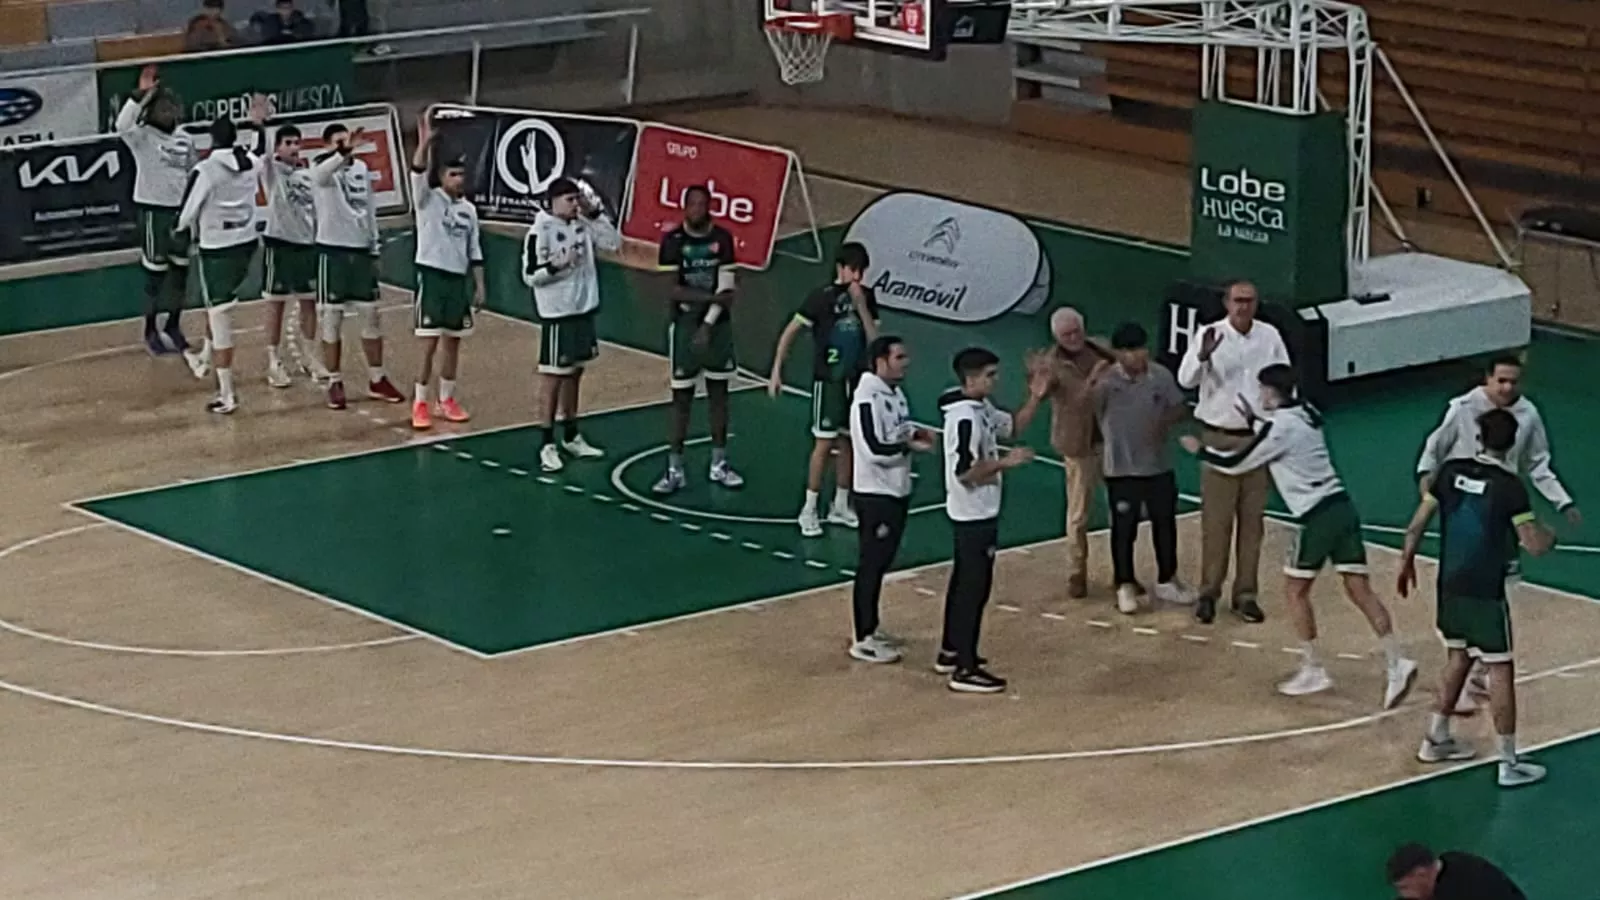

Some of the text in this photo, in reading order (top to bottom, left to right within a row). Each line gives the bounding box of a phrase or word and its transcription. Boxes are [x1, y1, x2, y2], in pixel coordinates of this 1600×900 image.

[19, 151, 120, 188] KIA
[1201, 167, 1286, 201] Lobe
[660, 177, 753, 222] Lbe
[873, 270, 968, 312] Aramóvil
[827, 348, 840, 363] 2
